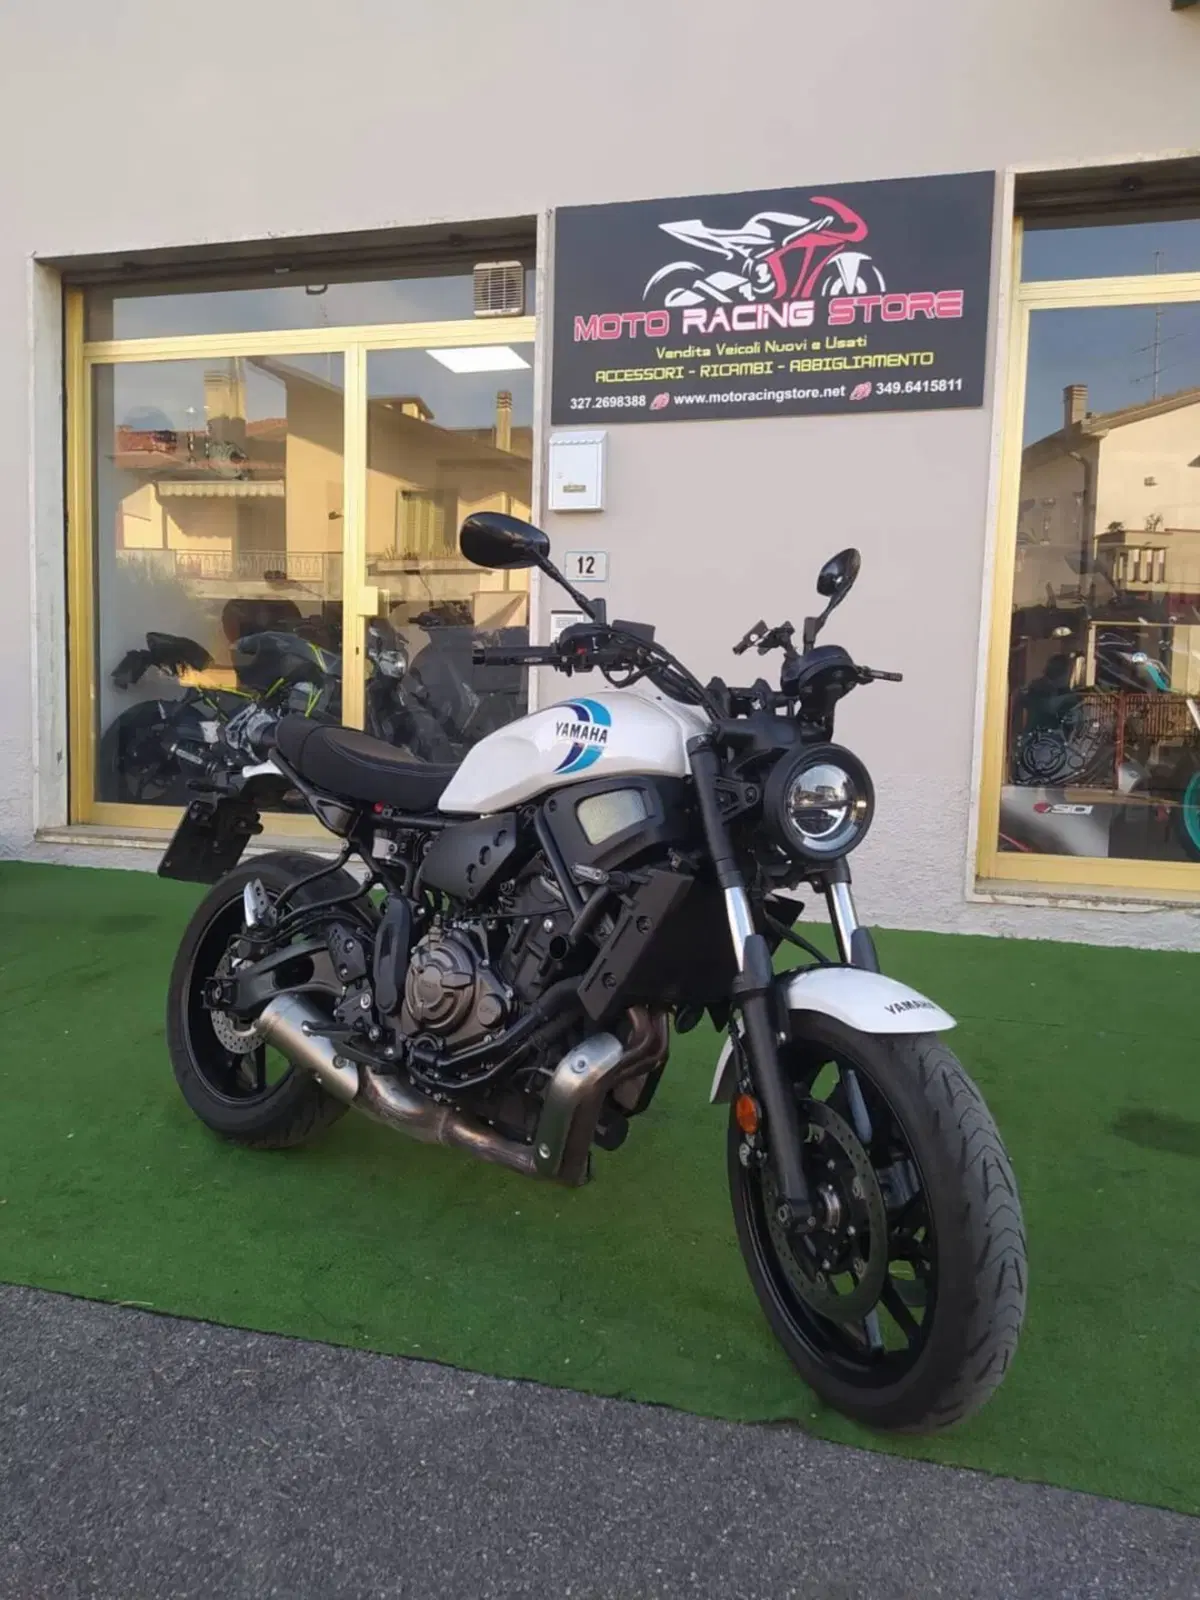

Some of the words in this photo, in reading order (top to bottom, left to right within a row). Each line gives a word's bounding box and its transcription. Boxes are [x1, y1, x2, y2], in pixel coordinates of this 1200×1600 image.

[573, 310, 670, 342] MOTO
[682, 300, 815, 335] RACING
[827, 290, 964, 326] STORE
[656, 345, 711, 359] Vendita
[716, 341, 761, 356] Veicoli
[765, 339, 807, 353] Nuovi
[811, 342, 821, 350] e
[825, 335, 868, 349] Usati
[595, 366, 684, 383] ACCESSORI
[700, 361, 774, 377] RICAMBI
[789, 352, 934, 373] ABBIGLIAMENTO
[570, 395, 646, 410] 327.2698388
[673, 385, 846, 405] www.motoracingstore.net
[876, 378, 963, 395] 349.6415811
[577, 556, 595, 574] 12
[556, 721, 608, 743] YAMAHA
